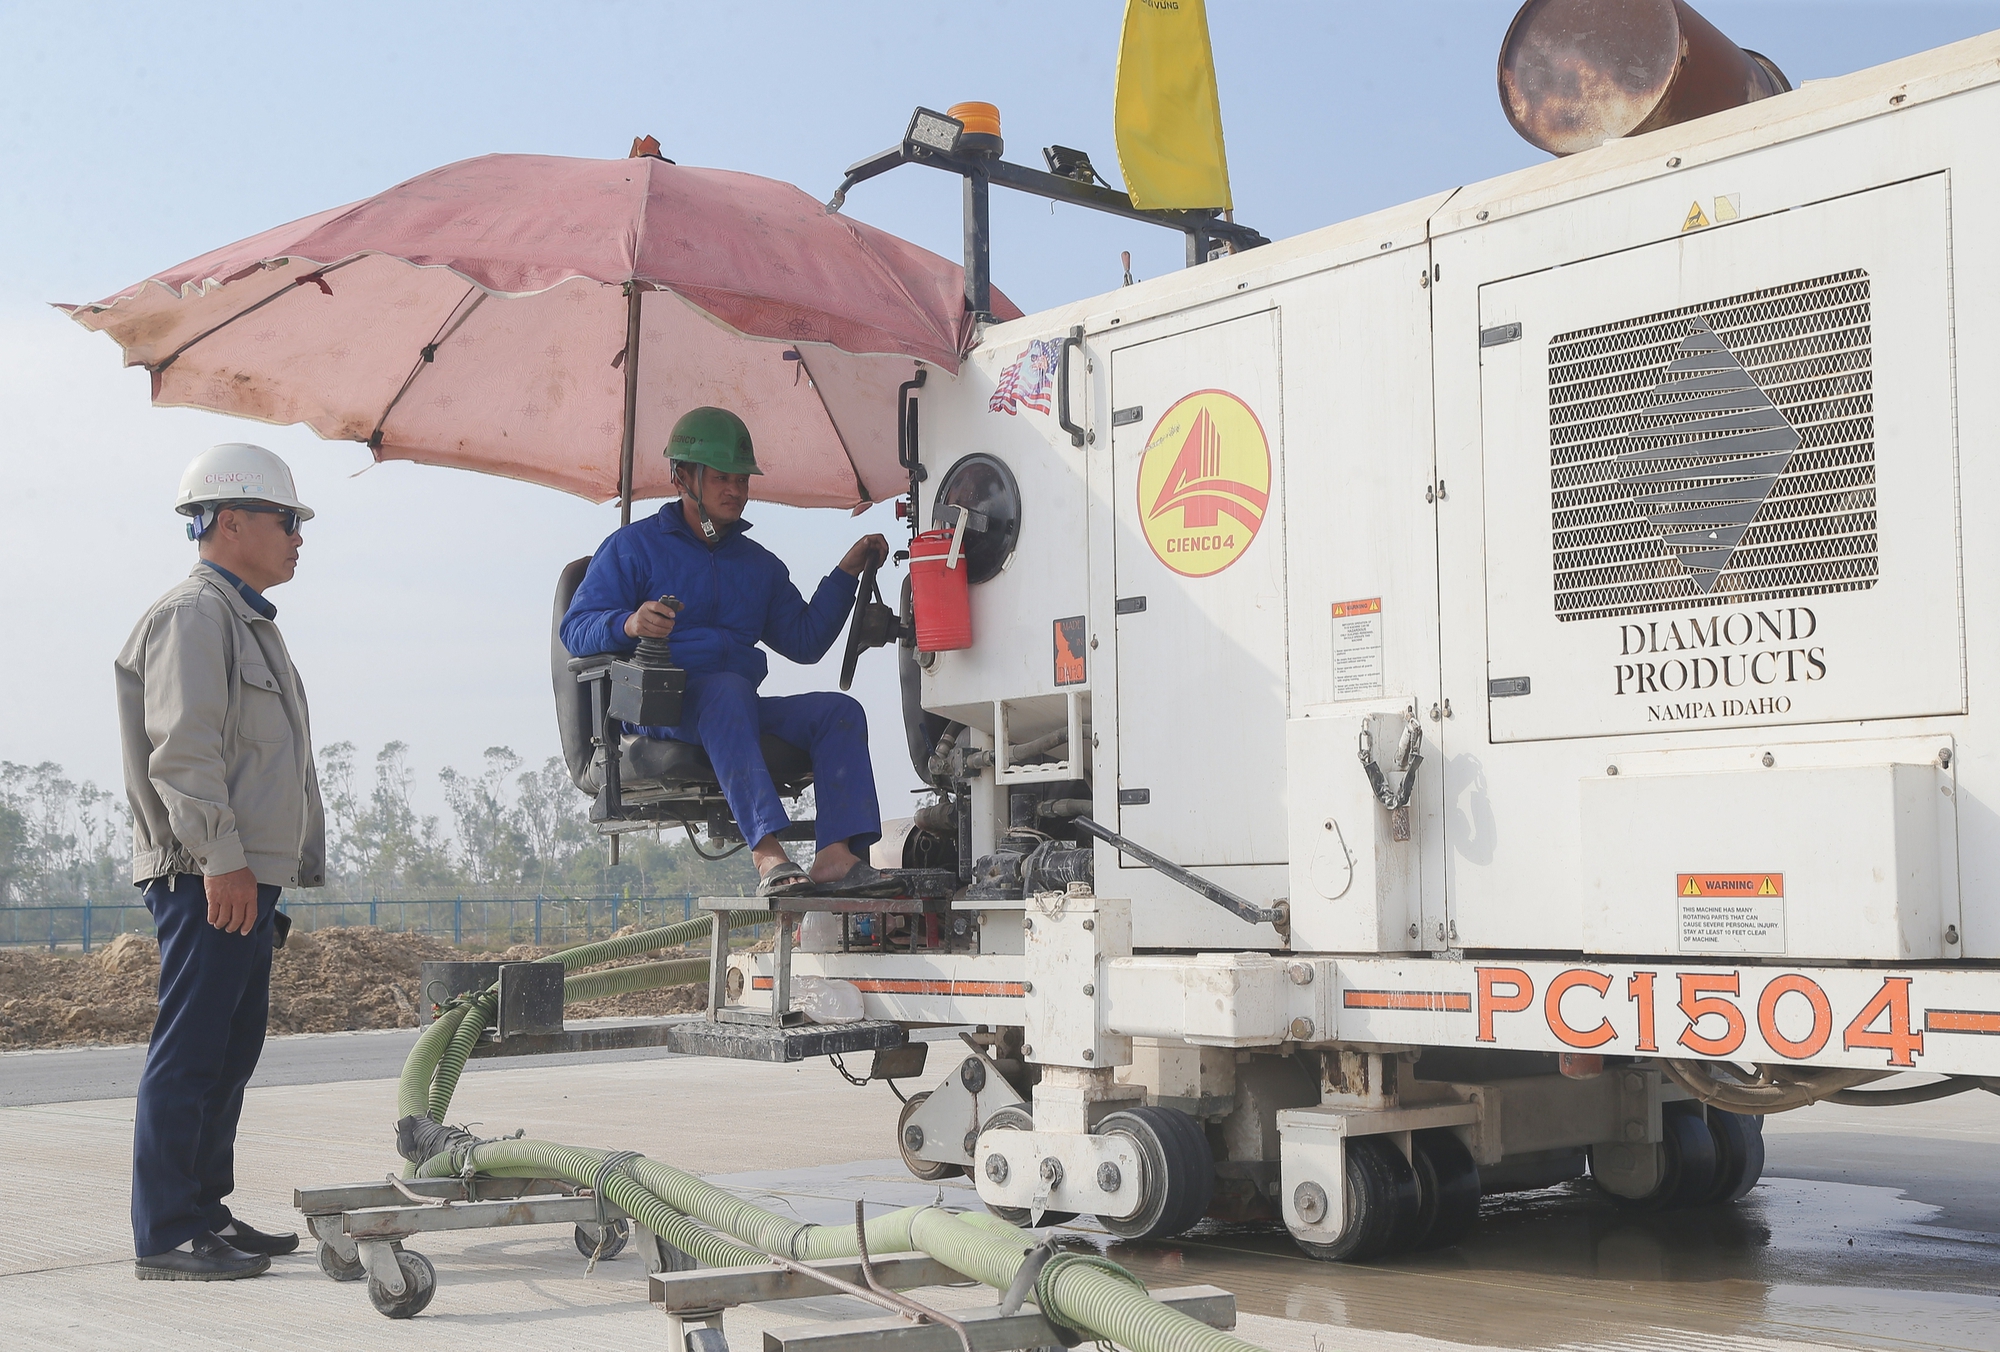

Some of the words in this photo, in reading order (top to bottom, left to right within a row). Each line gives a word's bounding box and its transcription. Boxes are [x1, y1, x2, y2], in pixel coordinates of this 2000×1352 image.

[1166, 534, 1235, 553] CIENCO4
[1062, 620, 1083, 631] MADE
[1619, 607, 1817, 656] DIAMOND
[1613, 647, 1827, 696] PRODUCTS
[1648, 702, 1717, 722] NAMPA
[1721, 695, 1792, 717] IDAHO
[1705, 881, 1754, 889] WARNING
[1474, 966, 1925, 1068] PC1504
